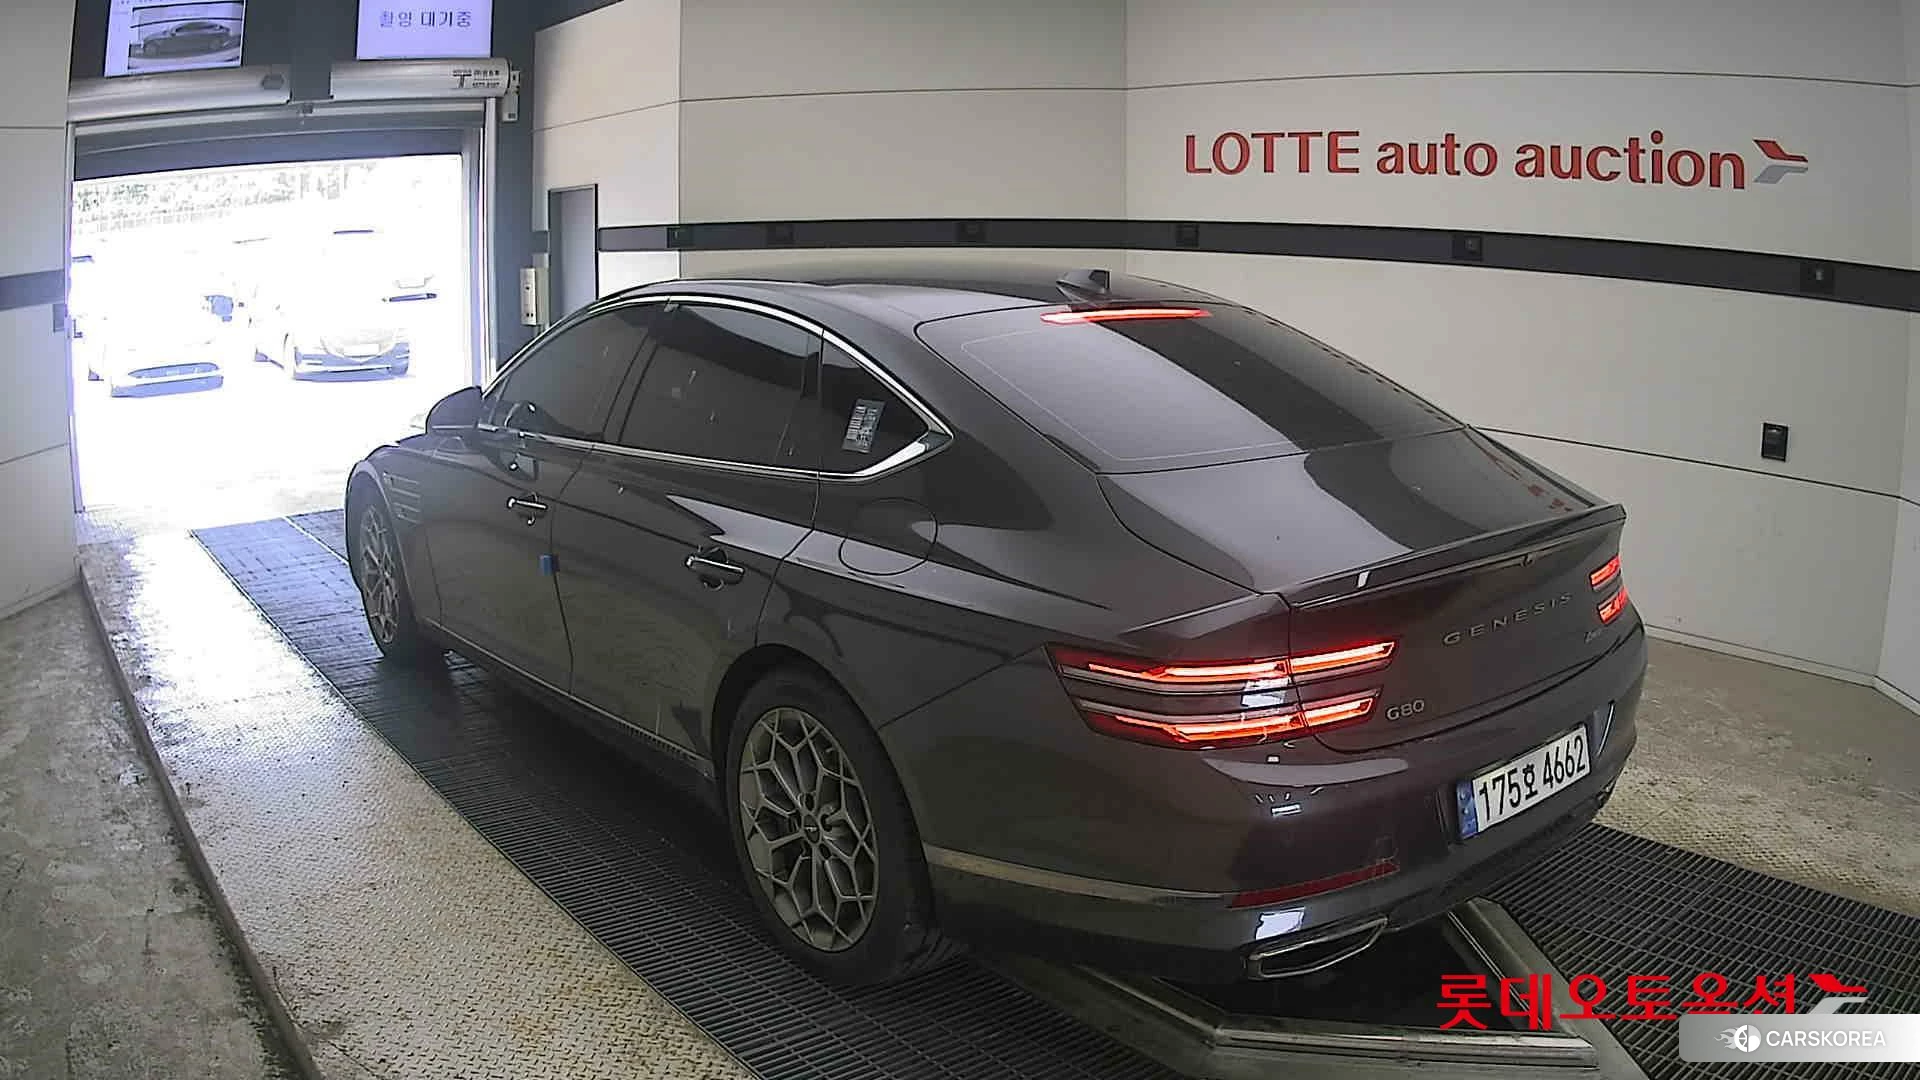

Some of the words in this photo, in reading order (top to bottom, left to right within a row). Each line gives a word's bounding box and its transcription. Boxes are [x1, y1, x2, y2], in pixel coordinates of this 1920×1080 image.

[420, 10, 472, 28] 대기중
[1185, 130, 1361, 175] LOTTE
[1376, 132, 1499, 178] auto
[1514, 130, 1747, 190] auction
[1443, 594, 1571, 646] GENESIS
[1386, 699, 1425, 721] G80
[1542, 734, 1587, 790] 4662
